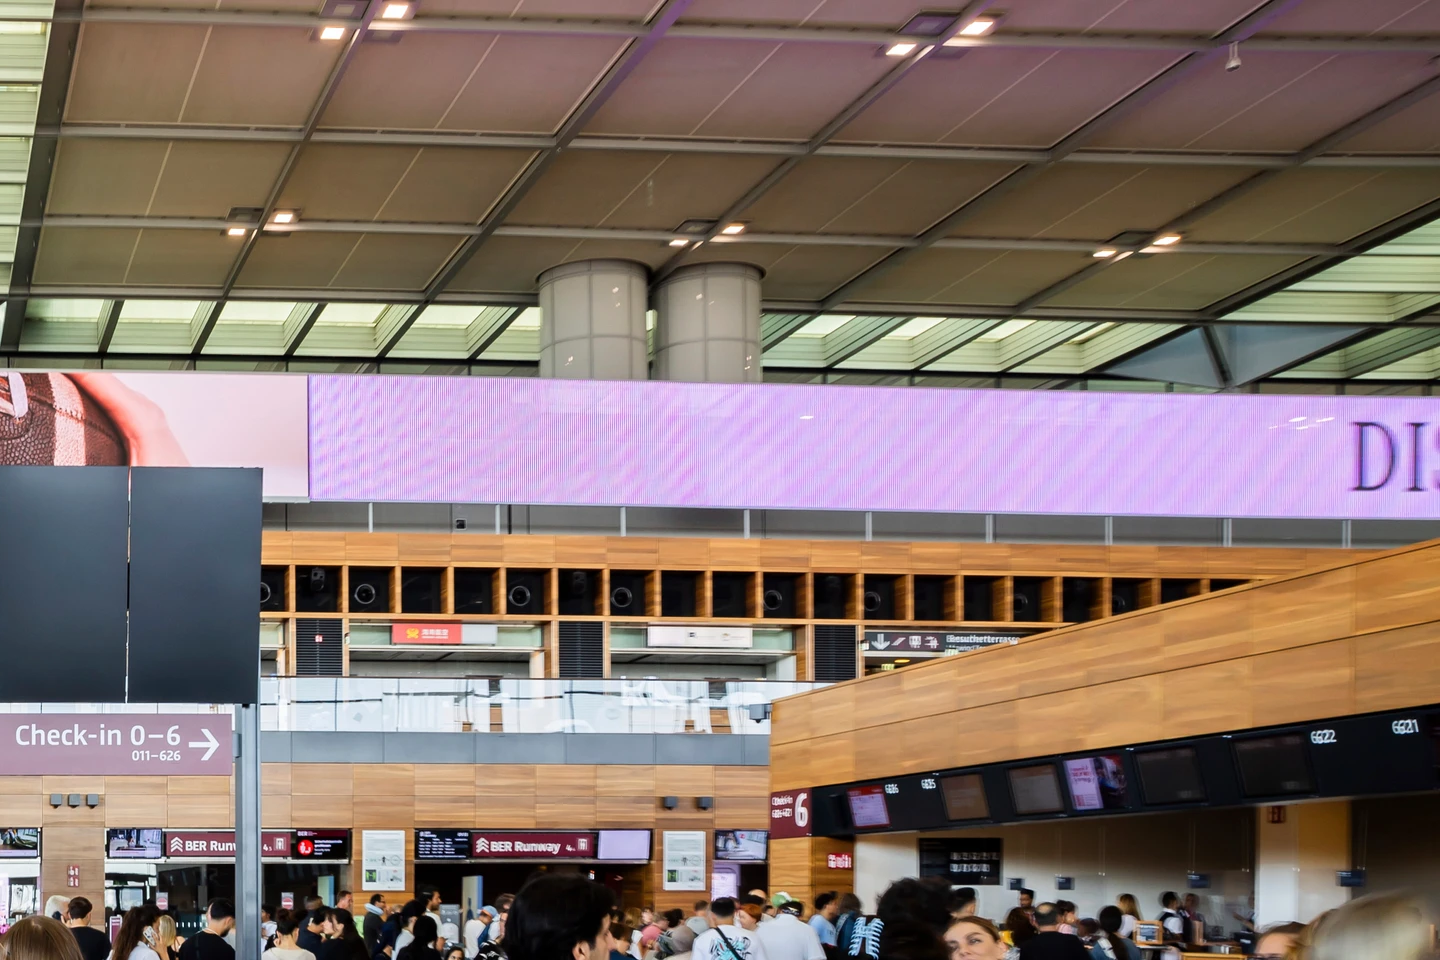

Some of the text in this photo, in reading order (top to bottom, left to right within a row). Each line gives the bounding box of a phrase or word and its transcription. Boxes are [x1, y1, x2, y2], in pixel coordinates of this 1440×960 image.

[1348, 421, 1440, 493] DI
[15, 723, 122, 746] Check-in
[794, 792, 809, 828] 6
[185, 840, 207, 852] BER
[490, 841, 561, 855] BER Runway
